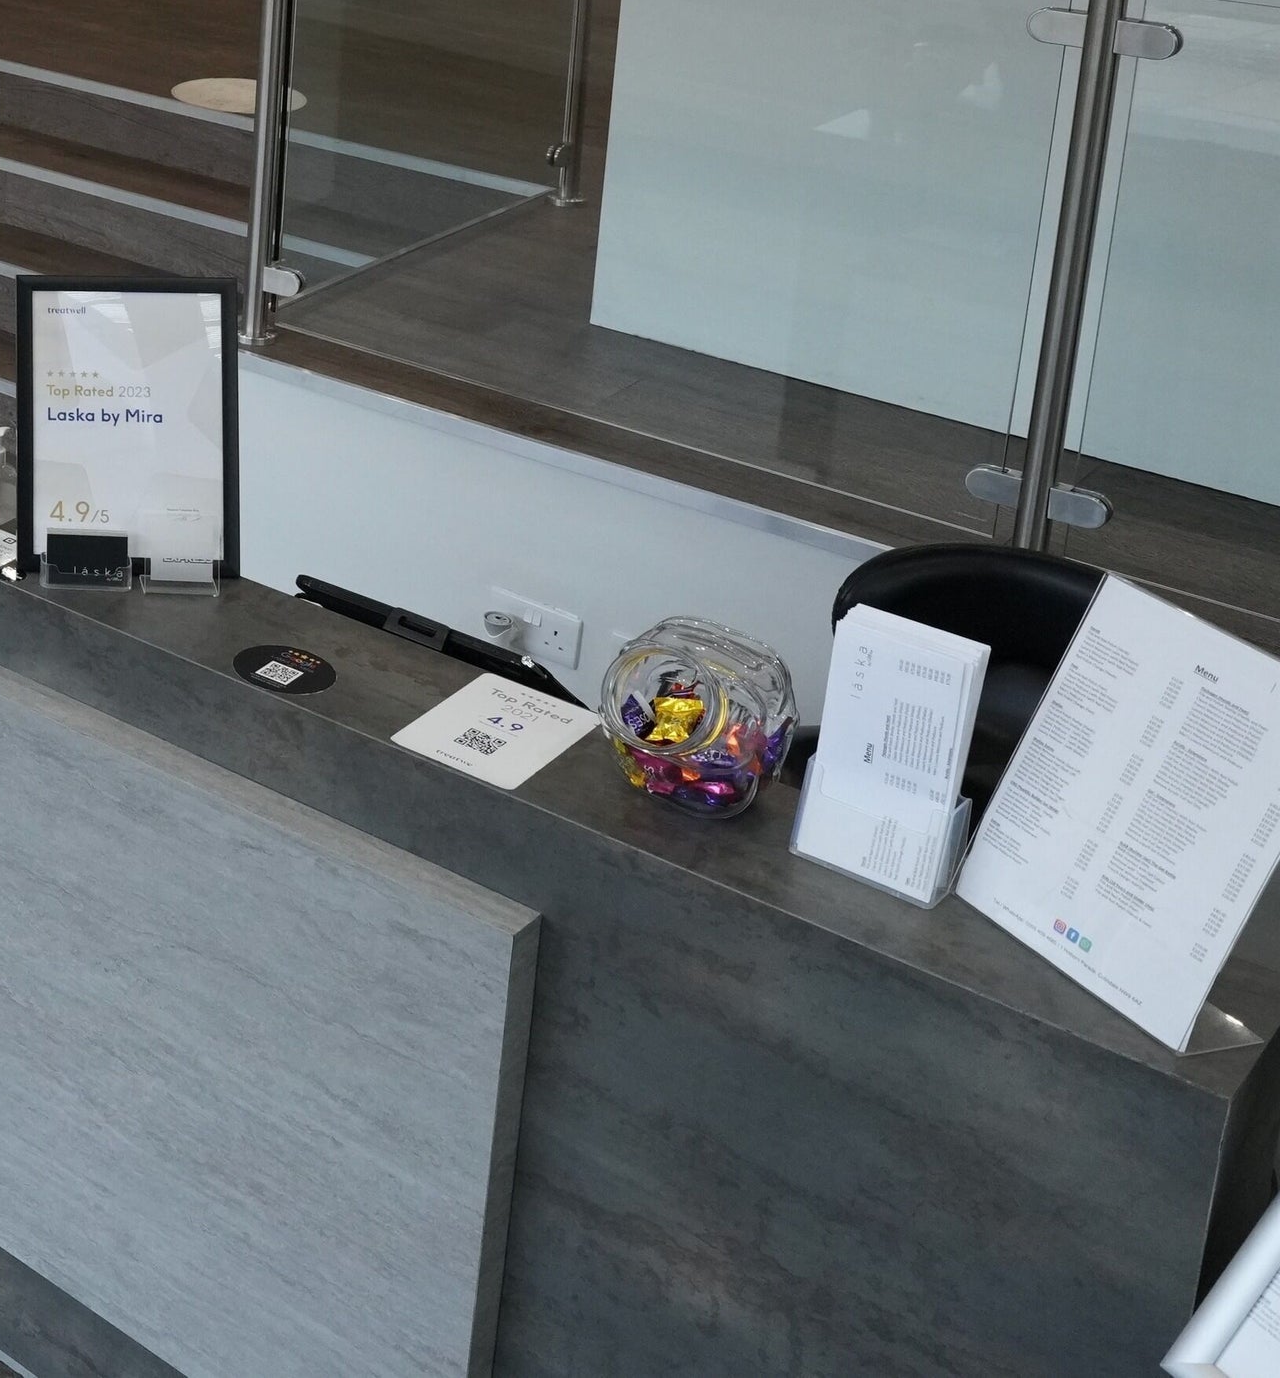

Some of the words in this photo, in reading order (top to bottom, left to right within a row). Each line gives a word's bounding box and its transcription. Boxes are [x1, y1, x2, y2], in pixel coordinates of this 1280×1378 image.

[47, 307, 86, 315] treatwell
[46, 384, 70, 399] Top
[74, 385, 114, 398] Rated
[118, 386, 151, 398] 2023
[47, 407, 95, 422] Laska
[101, 408, 120, 426] by
[125, 409, 163, 423] Mira
[1194, 665, 1219, 683] Menu
[491, 688, 518, 704] Top
[522, 700, 574, 725] Rated
[501, 705, 539, 722] 2021
[487, 716, 524, 732] 4.9
[864, 742, 874, 764] Menu
